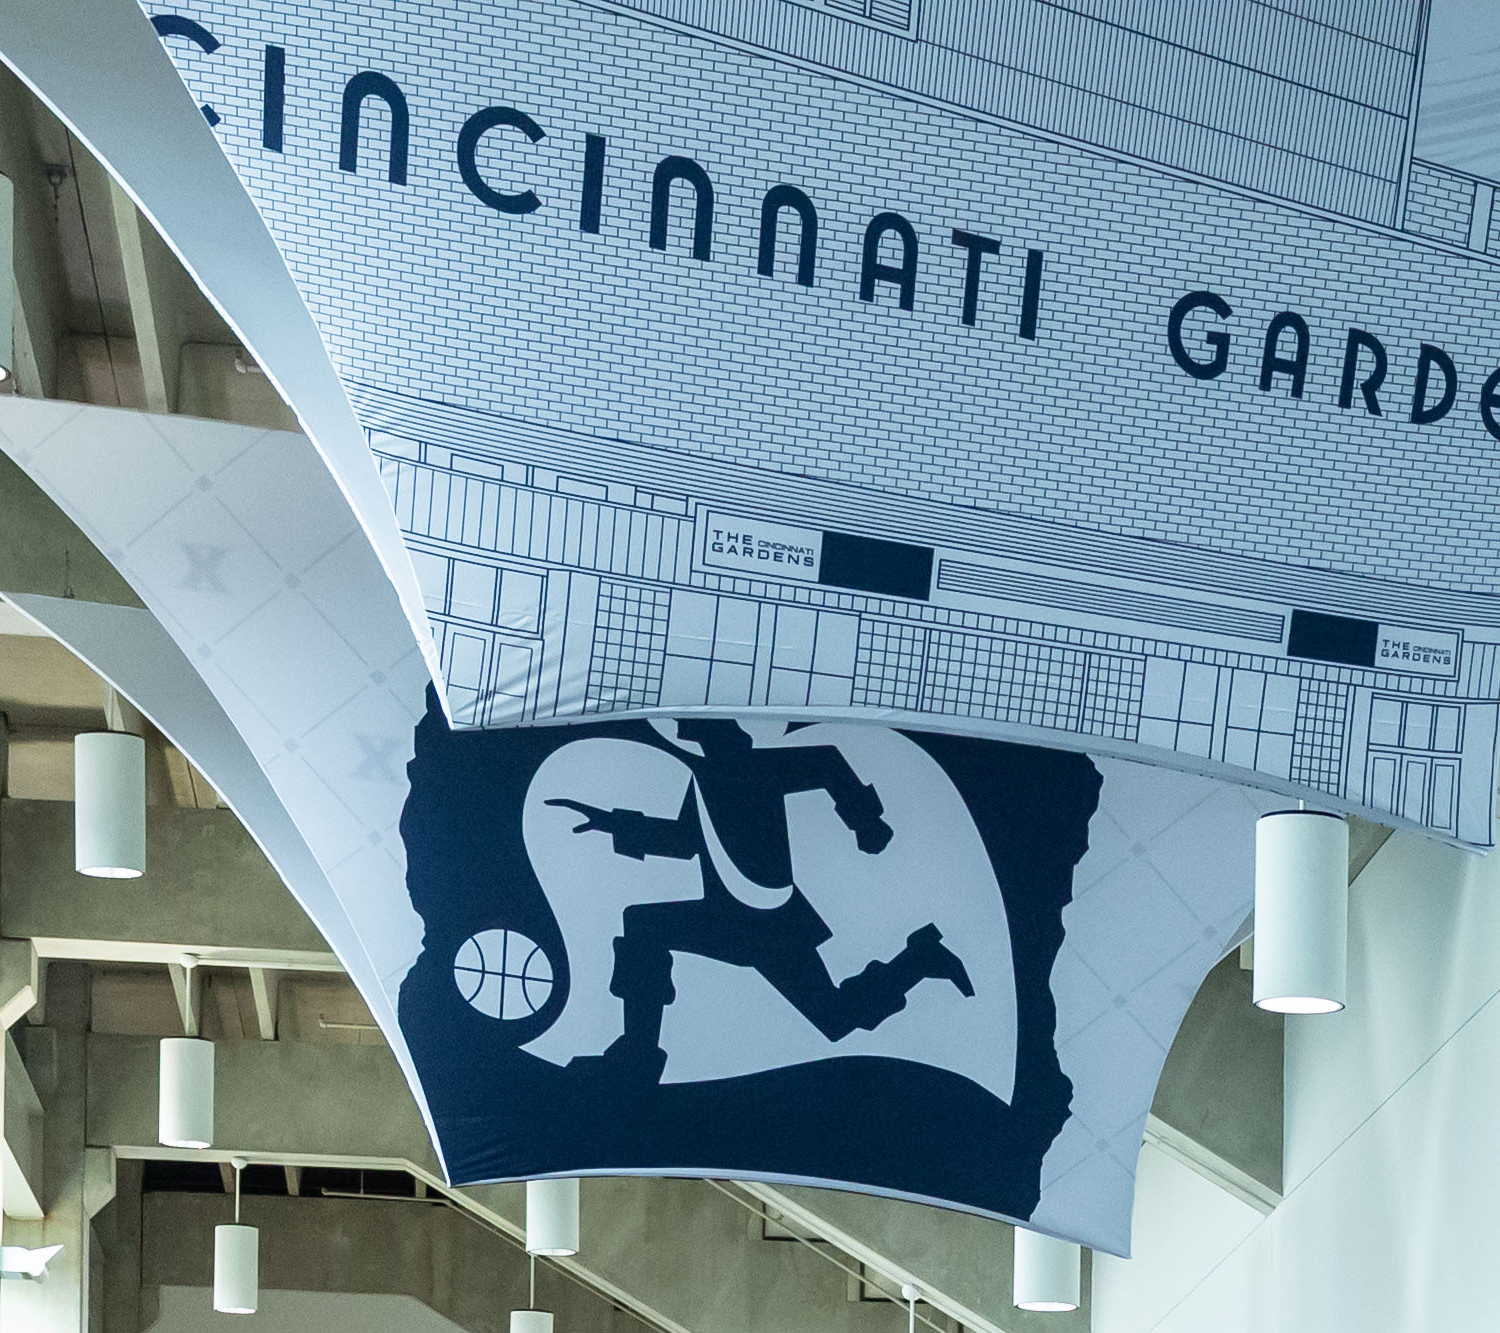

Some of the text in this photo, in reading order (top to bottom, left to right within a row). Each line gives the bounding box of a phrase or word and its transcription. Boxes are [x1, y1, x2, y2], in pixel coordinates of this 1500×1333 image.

[713, 530, 814, 556] THE CINCINNATI
[712, 542, 814, 567] GARDENS
[1383, 639, 1410, 650] THE
[1381, 649, 1451, 665] GARDENS
